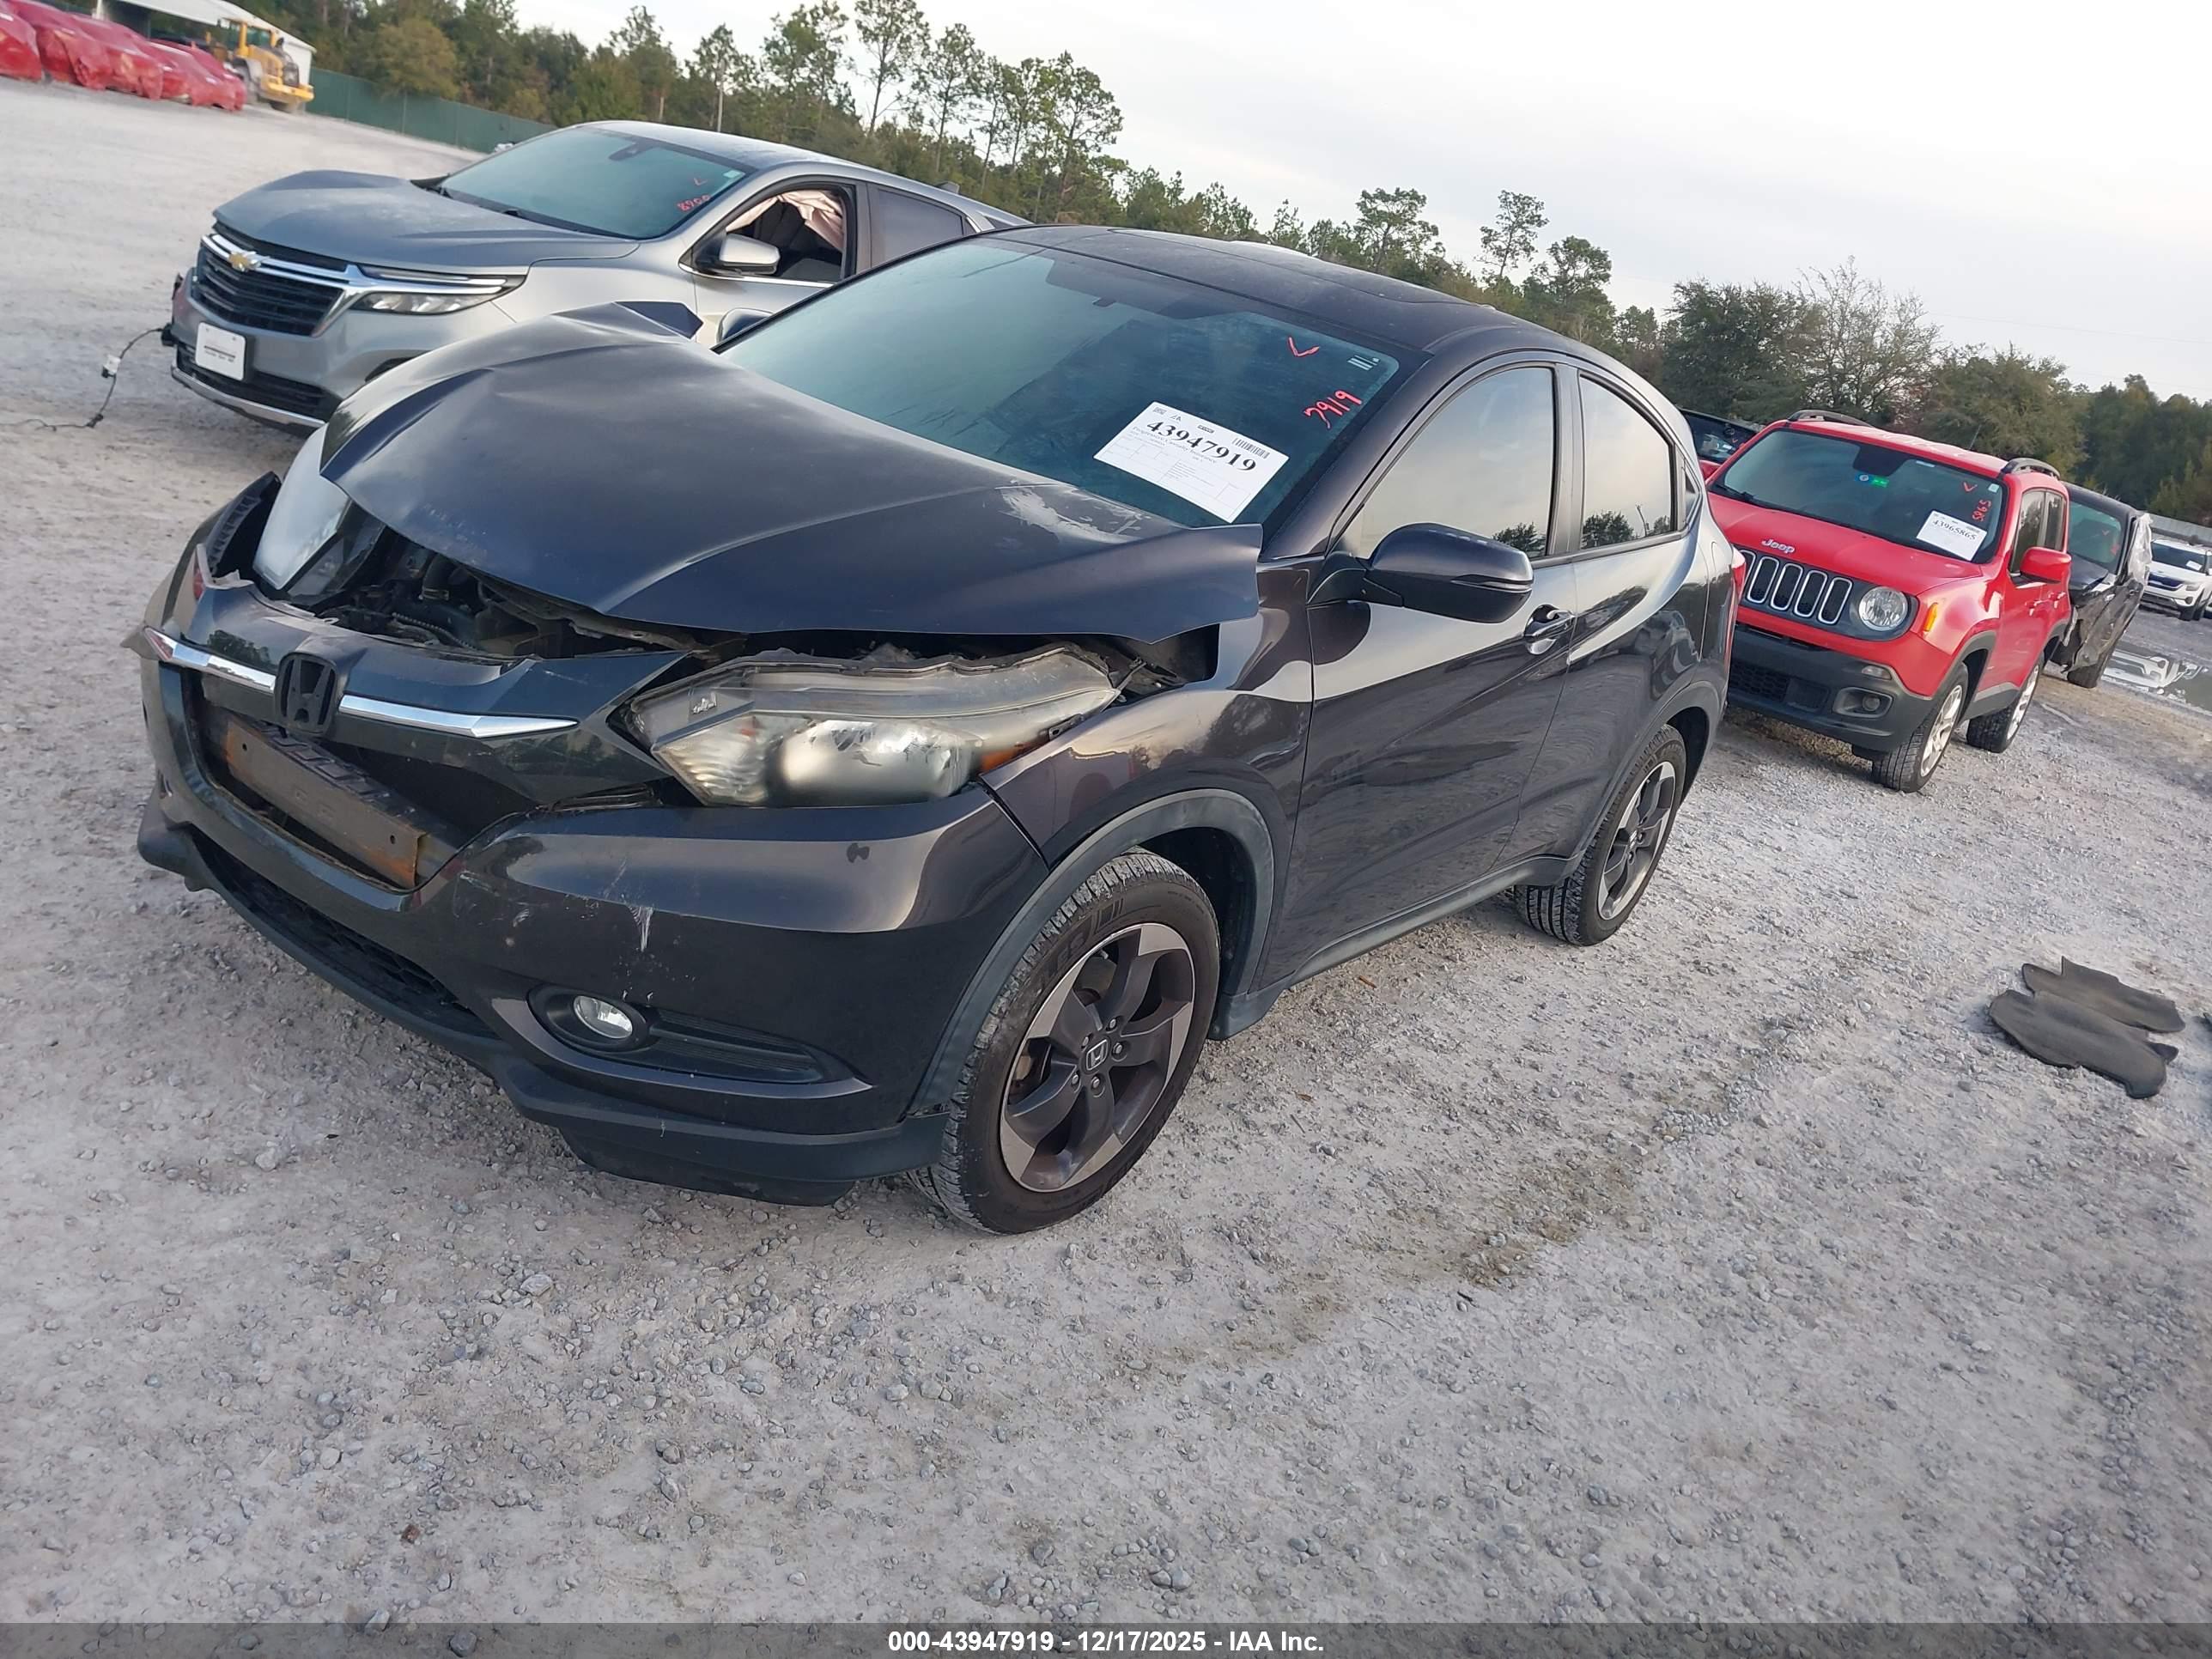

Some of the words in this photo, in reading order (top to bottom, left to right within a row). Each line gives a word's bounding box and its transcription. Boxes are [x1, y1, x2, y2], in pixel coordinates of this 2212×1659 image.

[1304, 389, 1363, 429] 7919
[1146, 421, 1257, 471] 43947919
[1932, 519, 1978, 541] 43965865
[1761, 538, 1796, 554] Jeep
